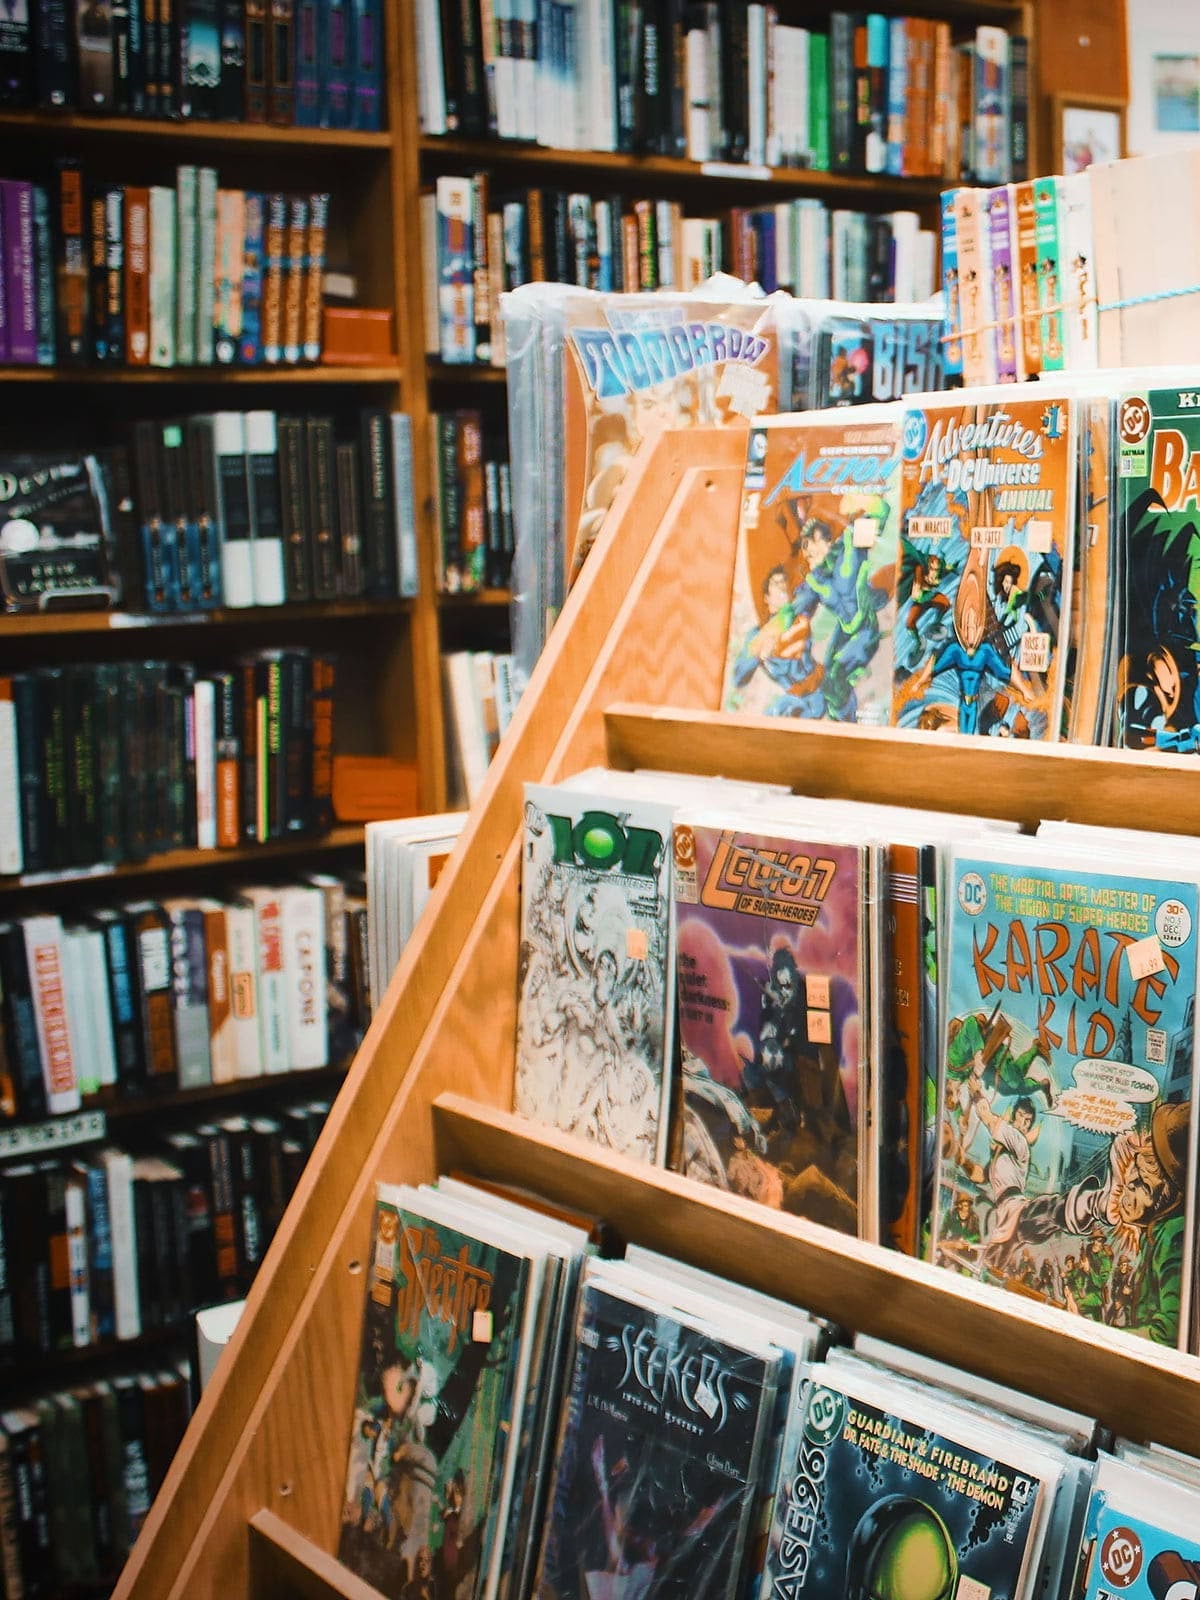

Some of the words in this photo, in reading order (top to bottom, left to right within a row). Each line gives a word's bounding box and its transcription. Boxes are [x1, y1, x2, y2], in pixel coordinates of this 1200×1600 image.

[573, 321, 770, 400] TOMORROW
[919, 411, 1044, 486] Adventures
[996, 490, 1055, 512] ANNUAL
[701, 829, 837, 911] LEGION
[989, 873, 1008, 893] THE
[1011, 877, 1057, 900] MARTIAL
[1060, 883, 1088, 904] ARTS
[1091, 888, 1138, 911] MASTER
[1141, 894, 1157, 913] OF
[741, 898, 752, 910] OF
[753, 900, 816, 923] SUPER-HEROES
[995, 894, 1013, 914] THE
[1015, 898, 1050, 919] LEGION
[1053, 903, 1066, 921] OF
[1069, 905, 1149, 934] SUPER-HEROES
[972, 919, 1181, 1027] KARATE
[1036, 996, 1116, 1059] KID
[847, 1409, 916, 1452] GUARDIAN
[918, 1441, 927, 1457] &
[929, 1446, 1009, 1492] FIREBRAND
[858, 1430, 880, 1455] FATE
[880, 1445, 889, 1458] &
[889, 1446, 909, 1467] THE
[907, 1454, 939, 1482] SHADE
[947, 1472, 967, 1492] THE
[966, 1480, 1004, 1511] DEMON
[1016, 1480, 1027, 1497] 4
[1111, 1541, 1133, 1571] DC
